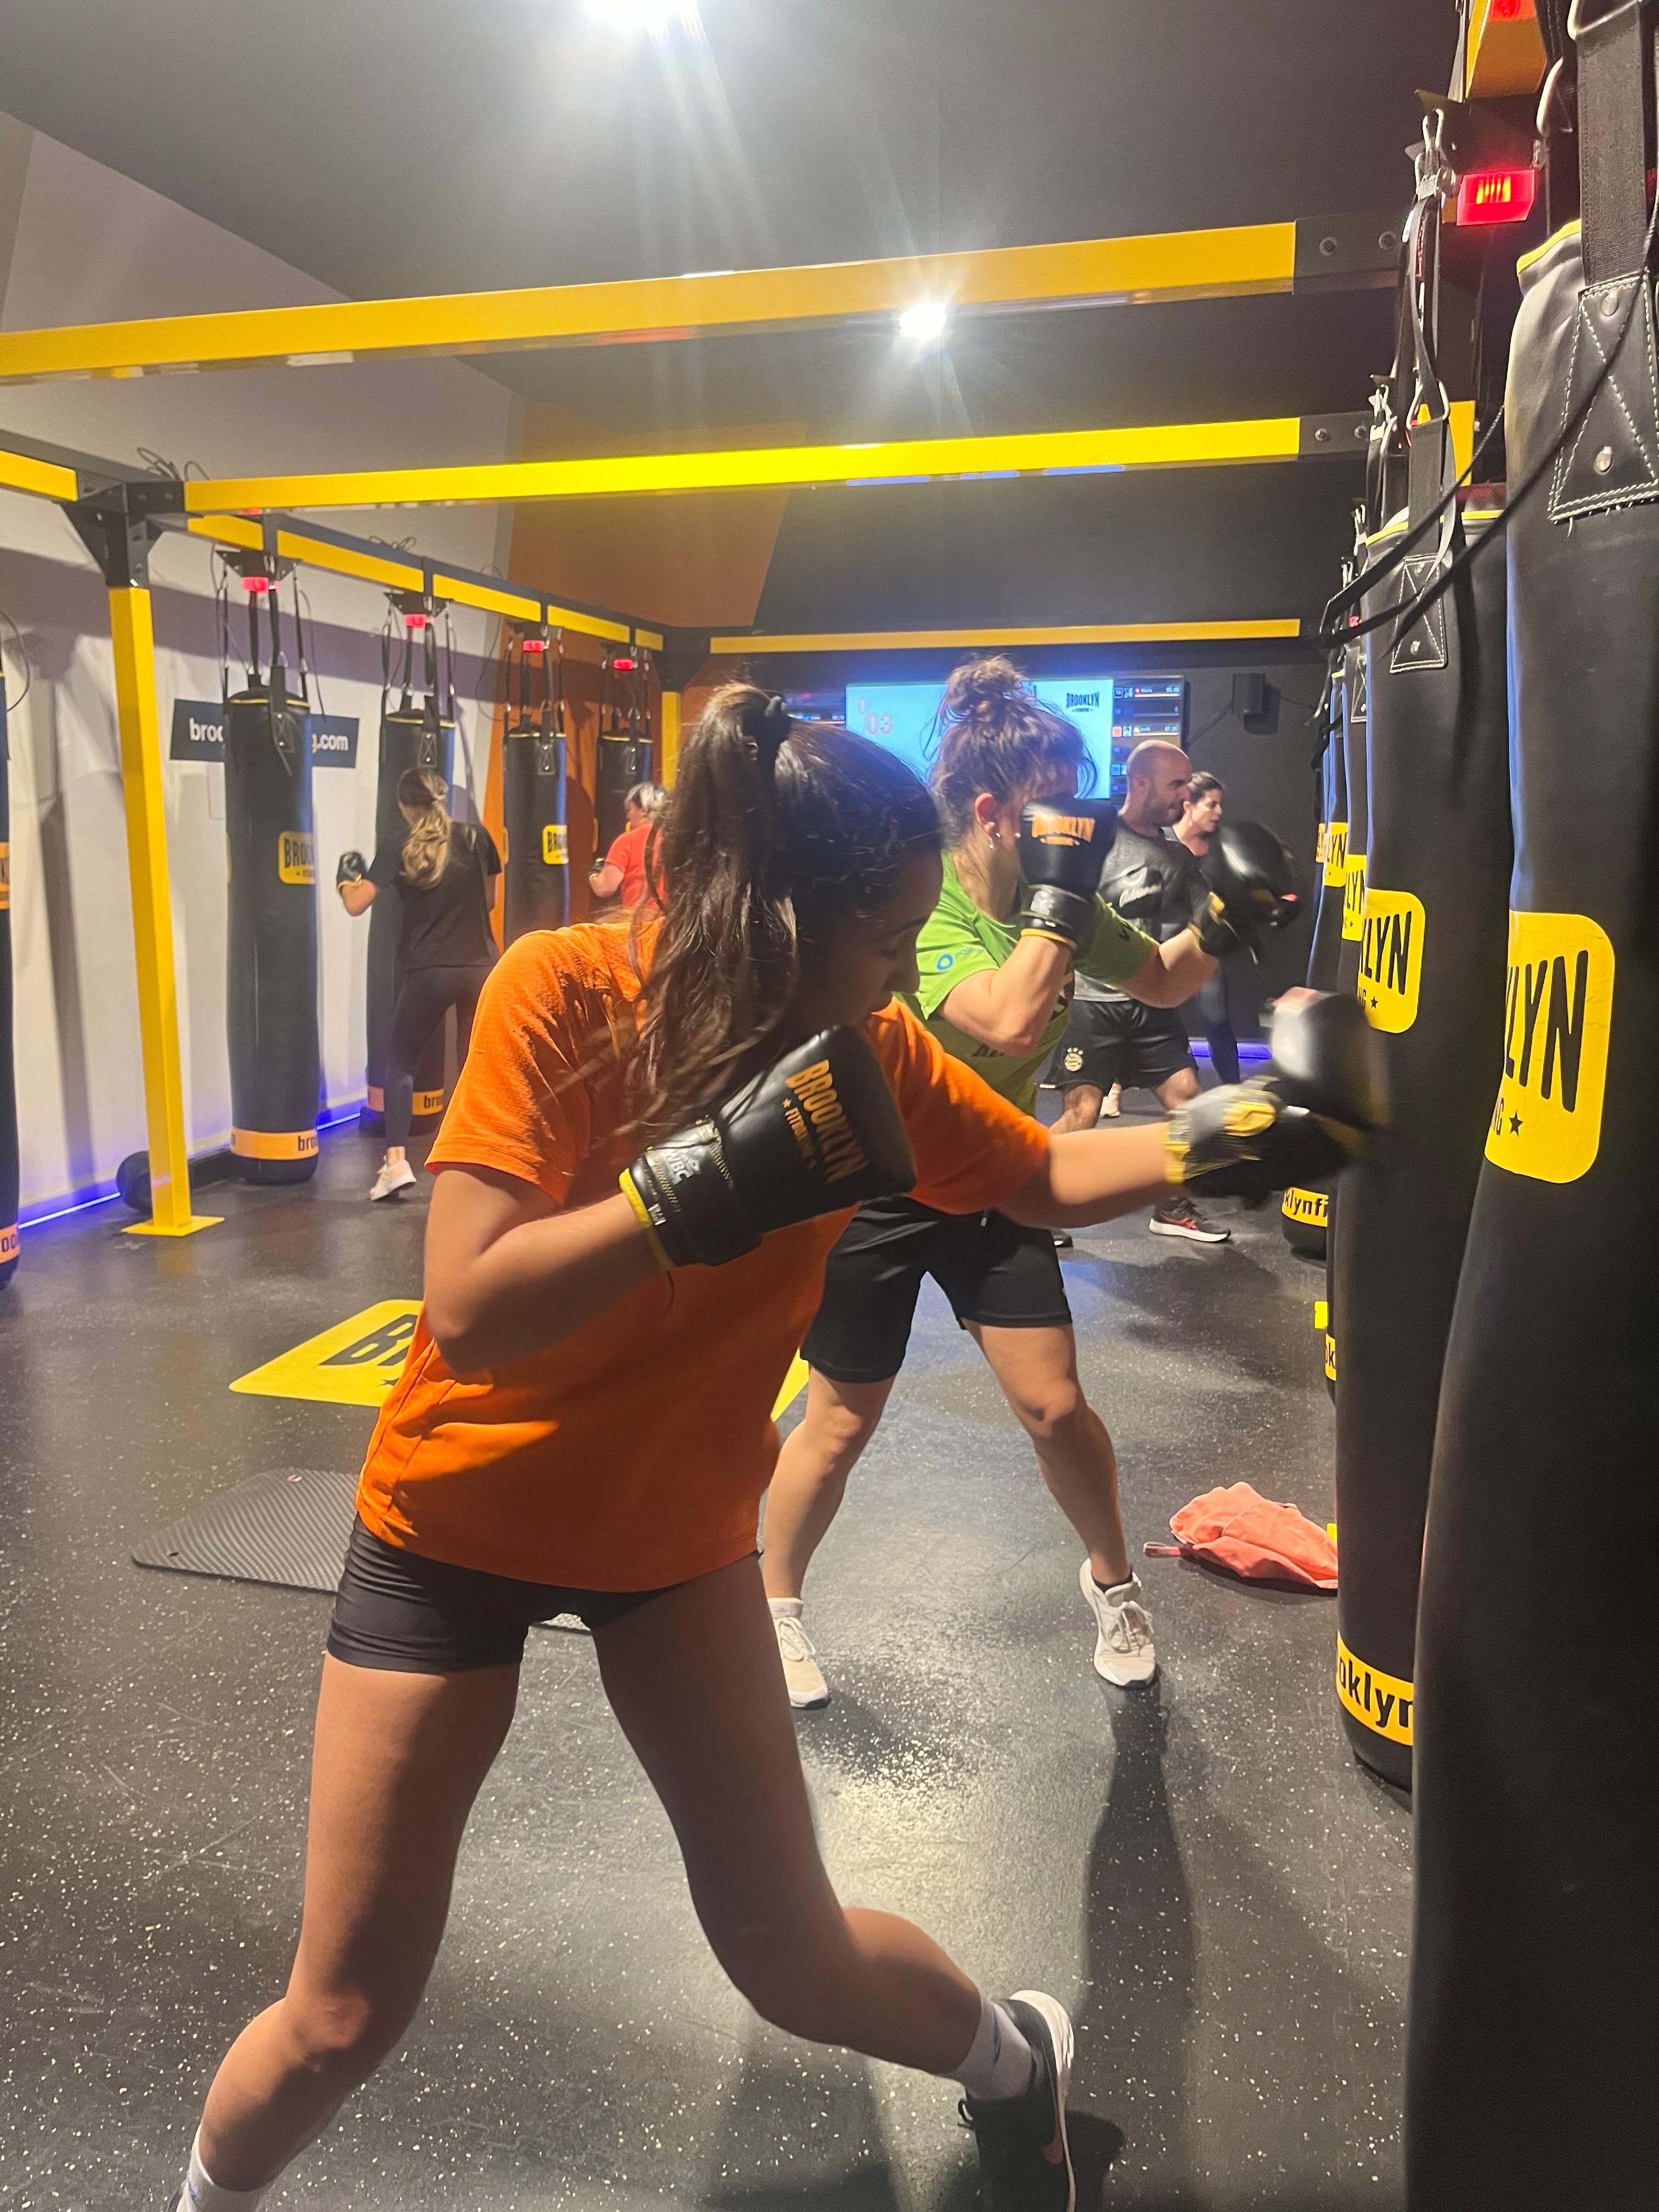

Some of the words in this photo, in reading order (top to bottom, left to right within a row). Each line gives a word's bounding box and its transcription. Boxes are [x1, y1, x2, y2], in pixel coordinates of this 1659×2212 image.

[1066, 692, 1099, 708] BROOKLYN
[866, 714, 893, 735] 03
[785, 1059, 870, 1184] BROOKLYN
